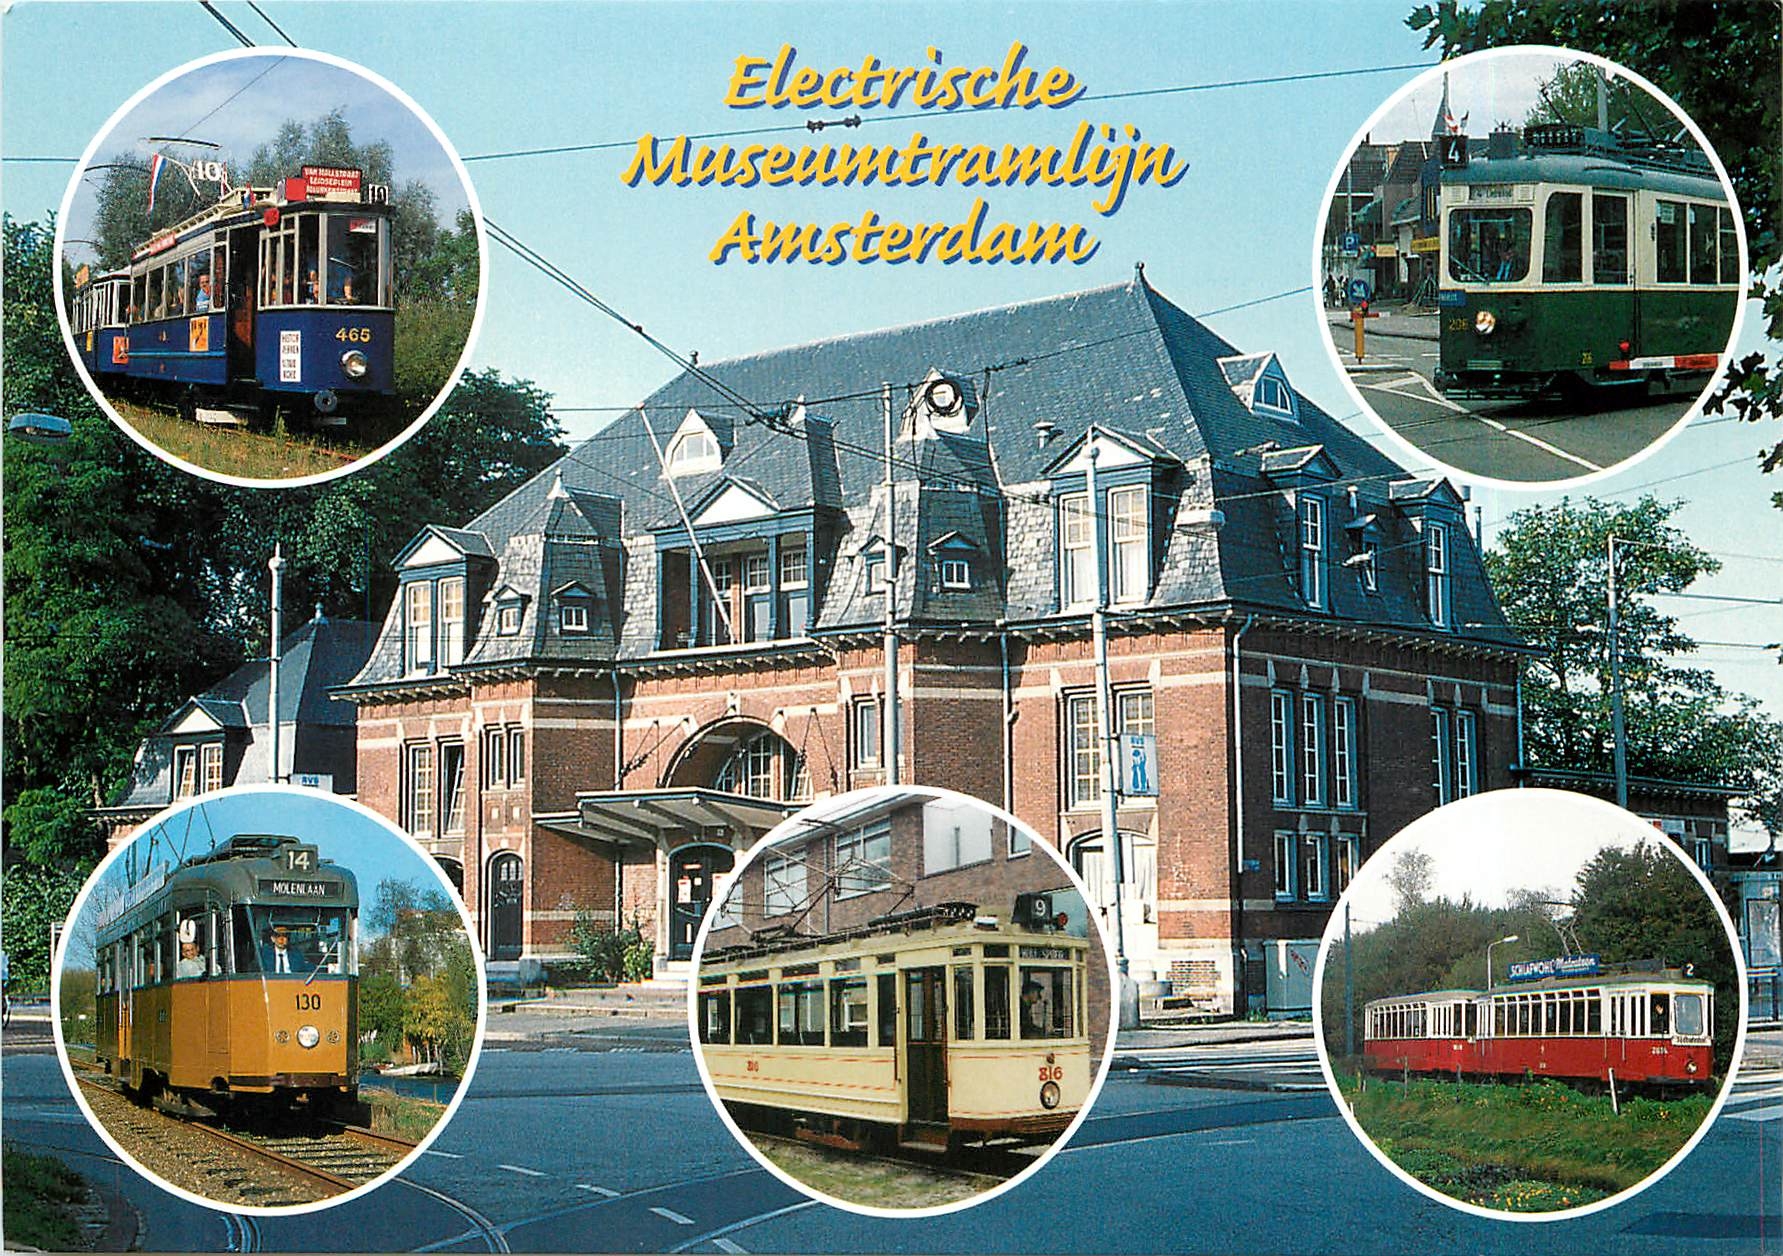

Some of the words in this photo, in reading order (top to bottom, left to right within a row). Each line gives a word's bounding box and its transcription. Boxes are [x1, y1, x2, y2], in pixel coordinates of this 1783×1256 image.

[1448, 139, 1460, 162] 4
[370, 185, 387, 204] 10
[335, 327, 371, 343] 465
[288, 850, 310, 870] 14
[272, 881, 325, 896] MOLENLAAN
[1035, 899, 1046, 917] 9
[1685, 962, 1694, 977] 2
[296, 993, 321, 1010] 130
[1039, 1066, 1062, 1081] 816
